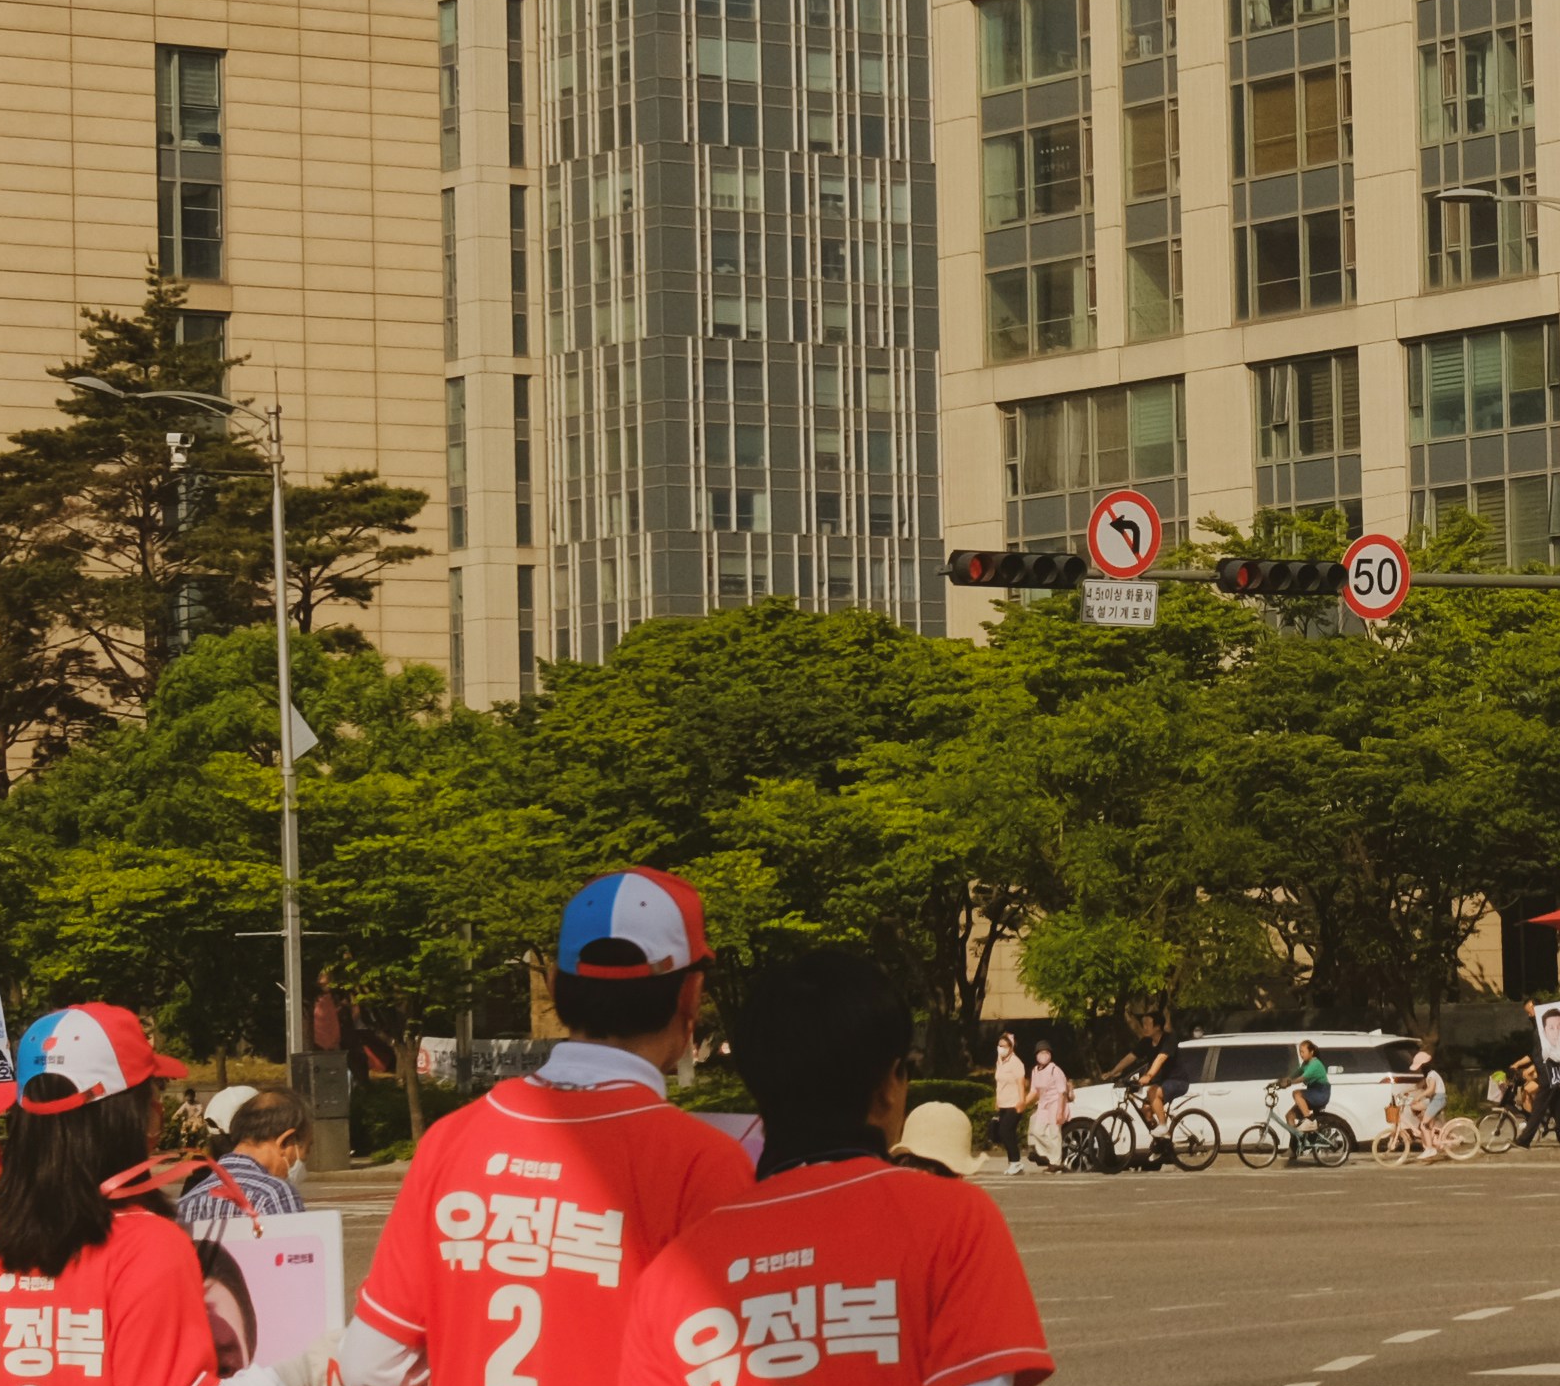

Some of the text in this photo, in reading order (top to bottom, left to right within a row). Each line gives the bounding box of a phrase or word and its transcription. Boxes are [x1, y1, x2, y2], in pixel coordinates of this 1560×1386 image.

[1352, 556, 1399, 596] 50
[509, 1157, 563, 1182] 국민의힘
[434, 1189, 625, 1289] 유정복
[753, 1246, 816, 1275] 국민의힘
